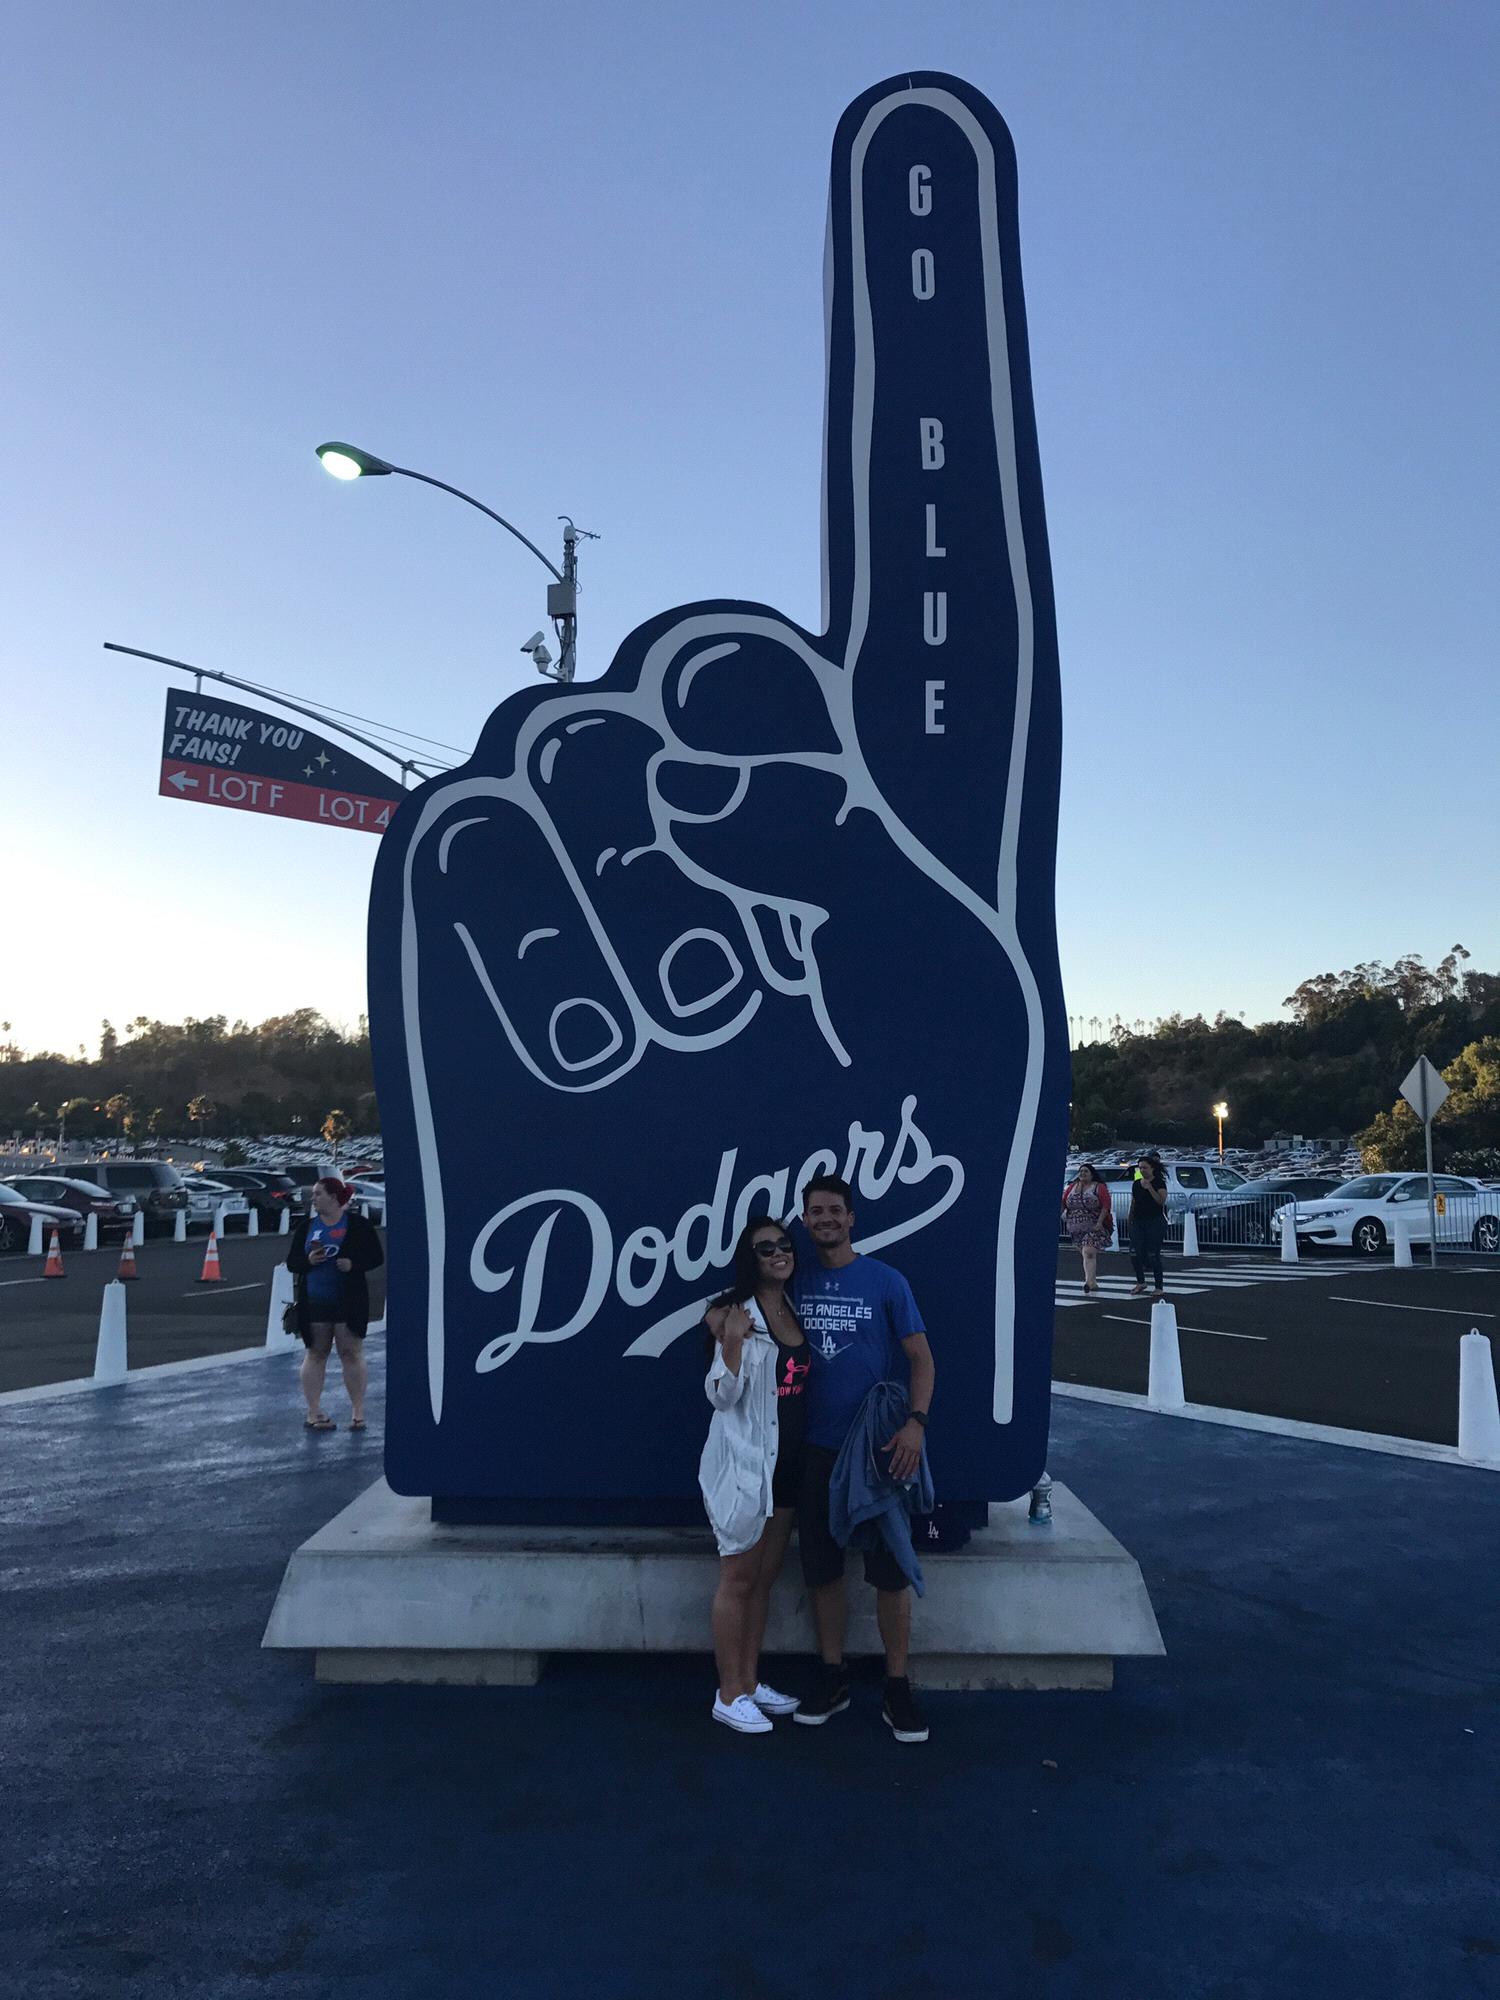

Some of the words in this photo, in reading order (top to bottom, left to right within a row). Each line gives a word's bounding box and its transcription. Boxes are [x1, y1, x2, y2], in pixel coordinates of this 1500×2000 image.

[908, 164, 936, 301] GO
[920, 417, 948, 735] BLUE
[174, 706, 254, 740] THANK
[259, 723, 304, 750] YOU
[168, 734, 242, 766] FANS!
[208, 773, 263, 805] LOT
[269, 784, 284, 808] F
[319, 793, 369, 824] LOT
[796, 1303, 814, 1316] OS
[815, 1304, 873, 1320] ANGELES
[803, 1317, 857, 1332] DODGERS
[821, 1330, 837, 1354] LA
[927, 1520, 939, 1539] LA
